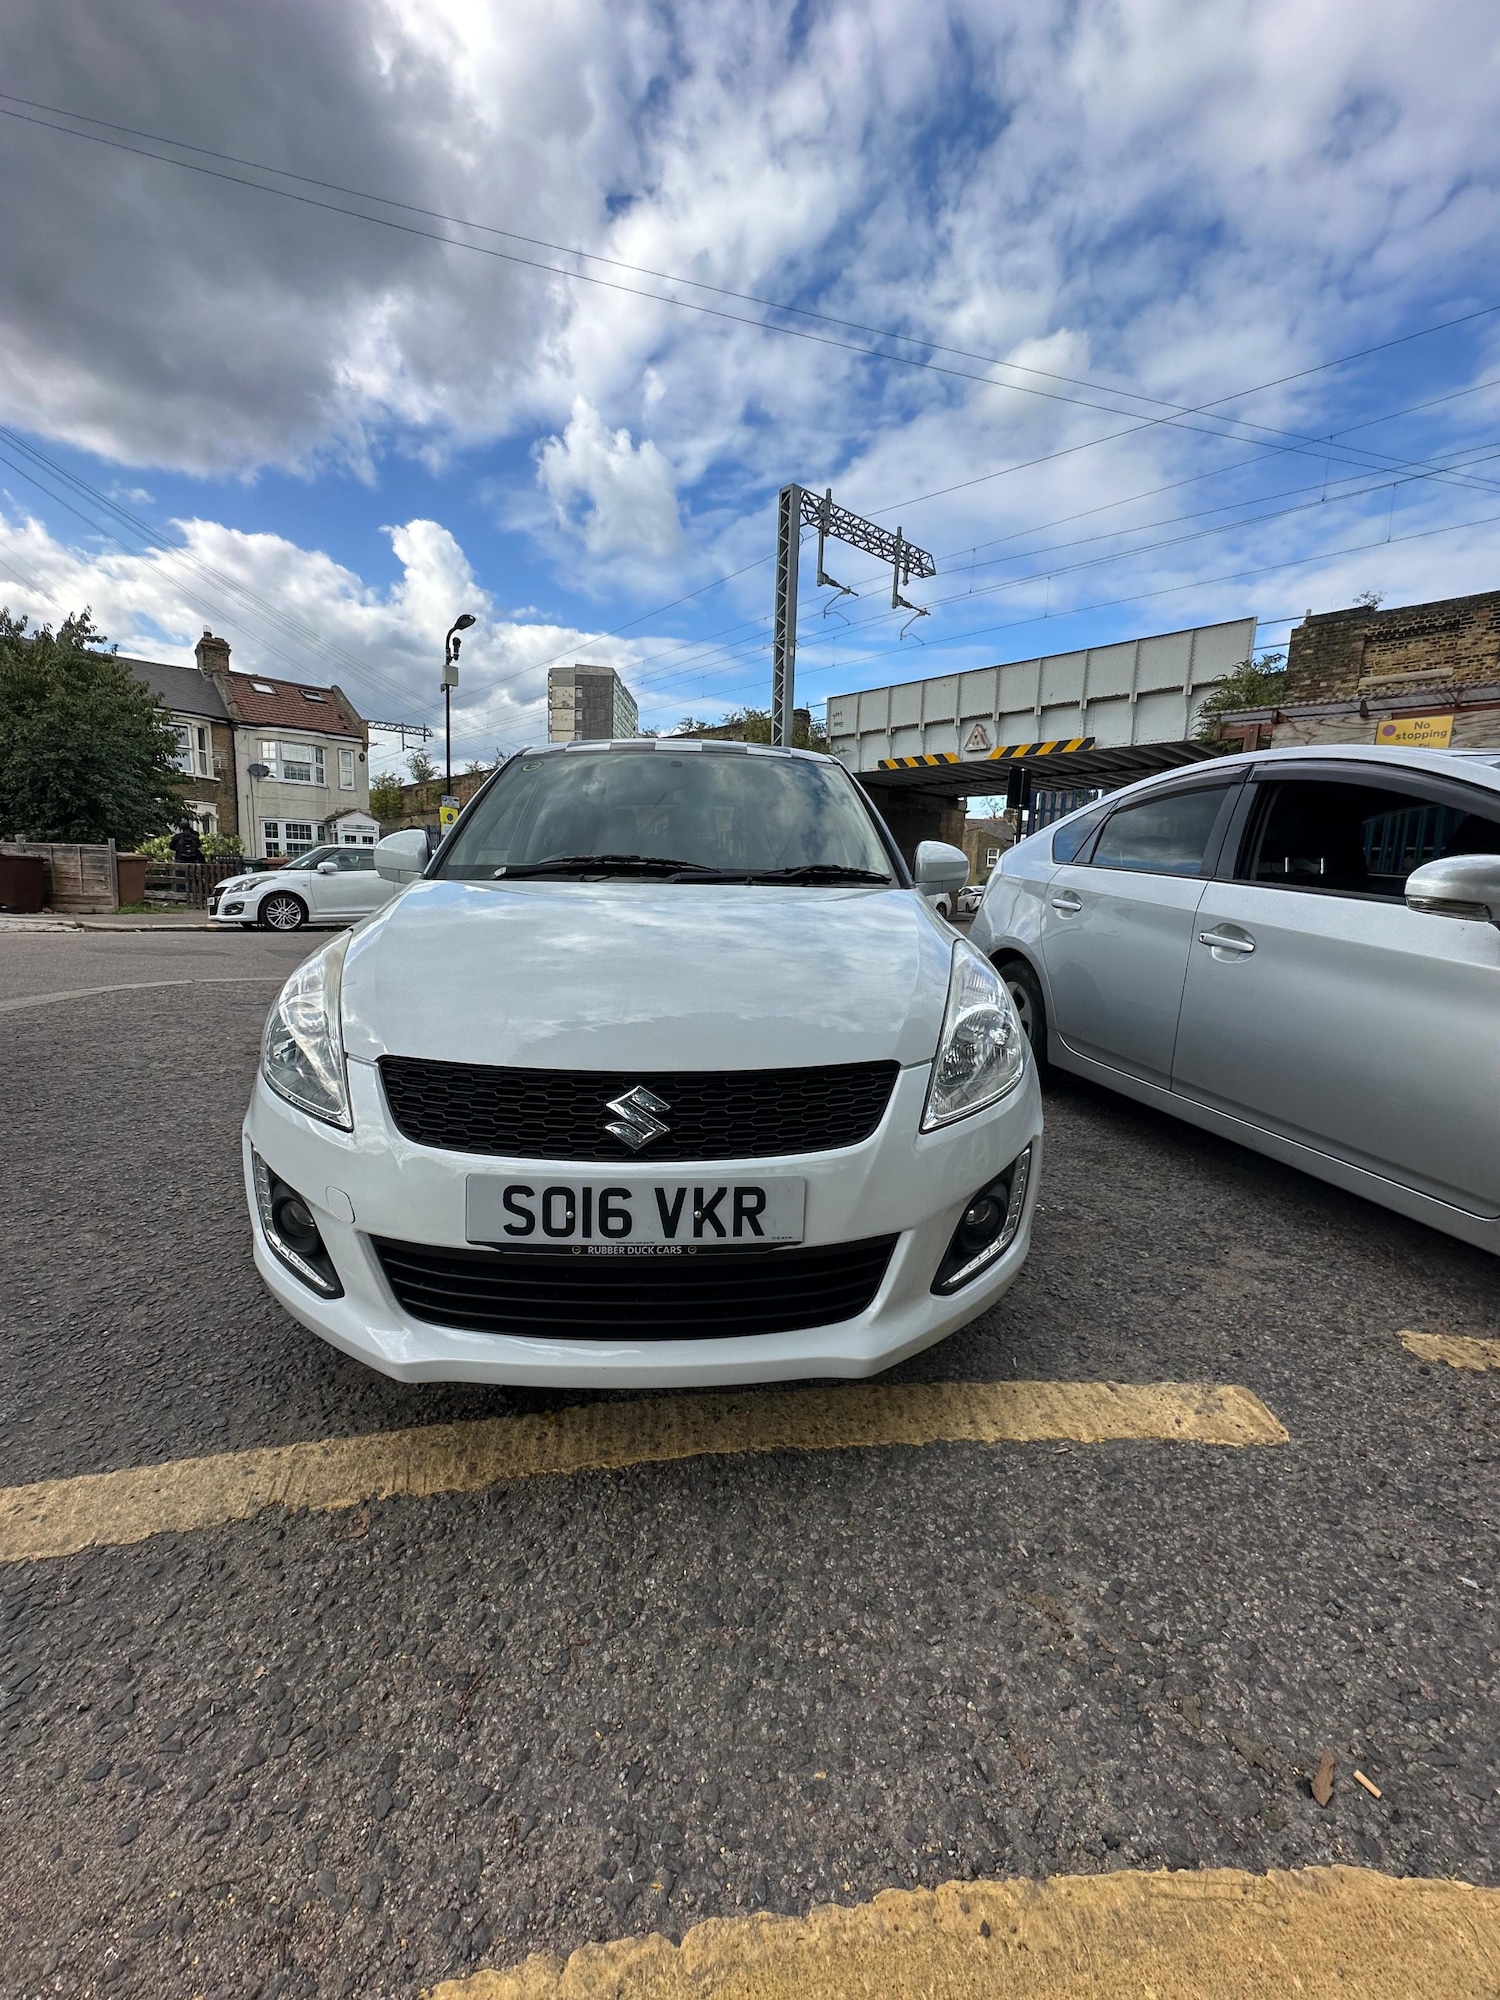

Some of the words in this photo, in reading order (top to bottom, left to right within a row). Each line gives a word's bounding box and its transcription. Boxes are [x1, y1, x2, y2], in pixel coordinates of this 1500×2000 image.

[1414, 721, 1430, 730] No
[1395, 729, 1448, 741] stopping
[502, 1184, 633, 1239] SO16
[654, 1186, 767, 1239] VKR
[587, 1246, 626, 1255] RUBBER
[627, 1246, 655, 1255] DUCK
[656, 1246, 682, 1255] CARS
